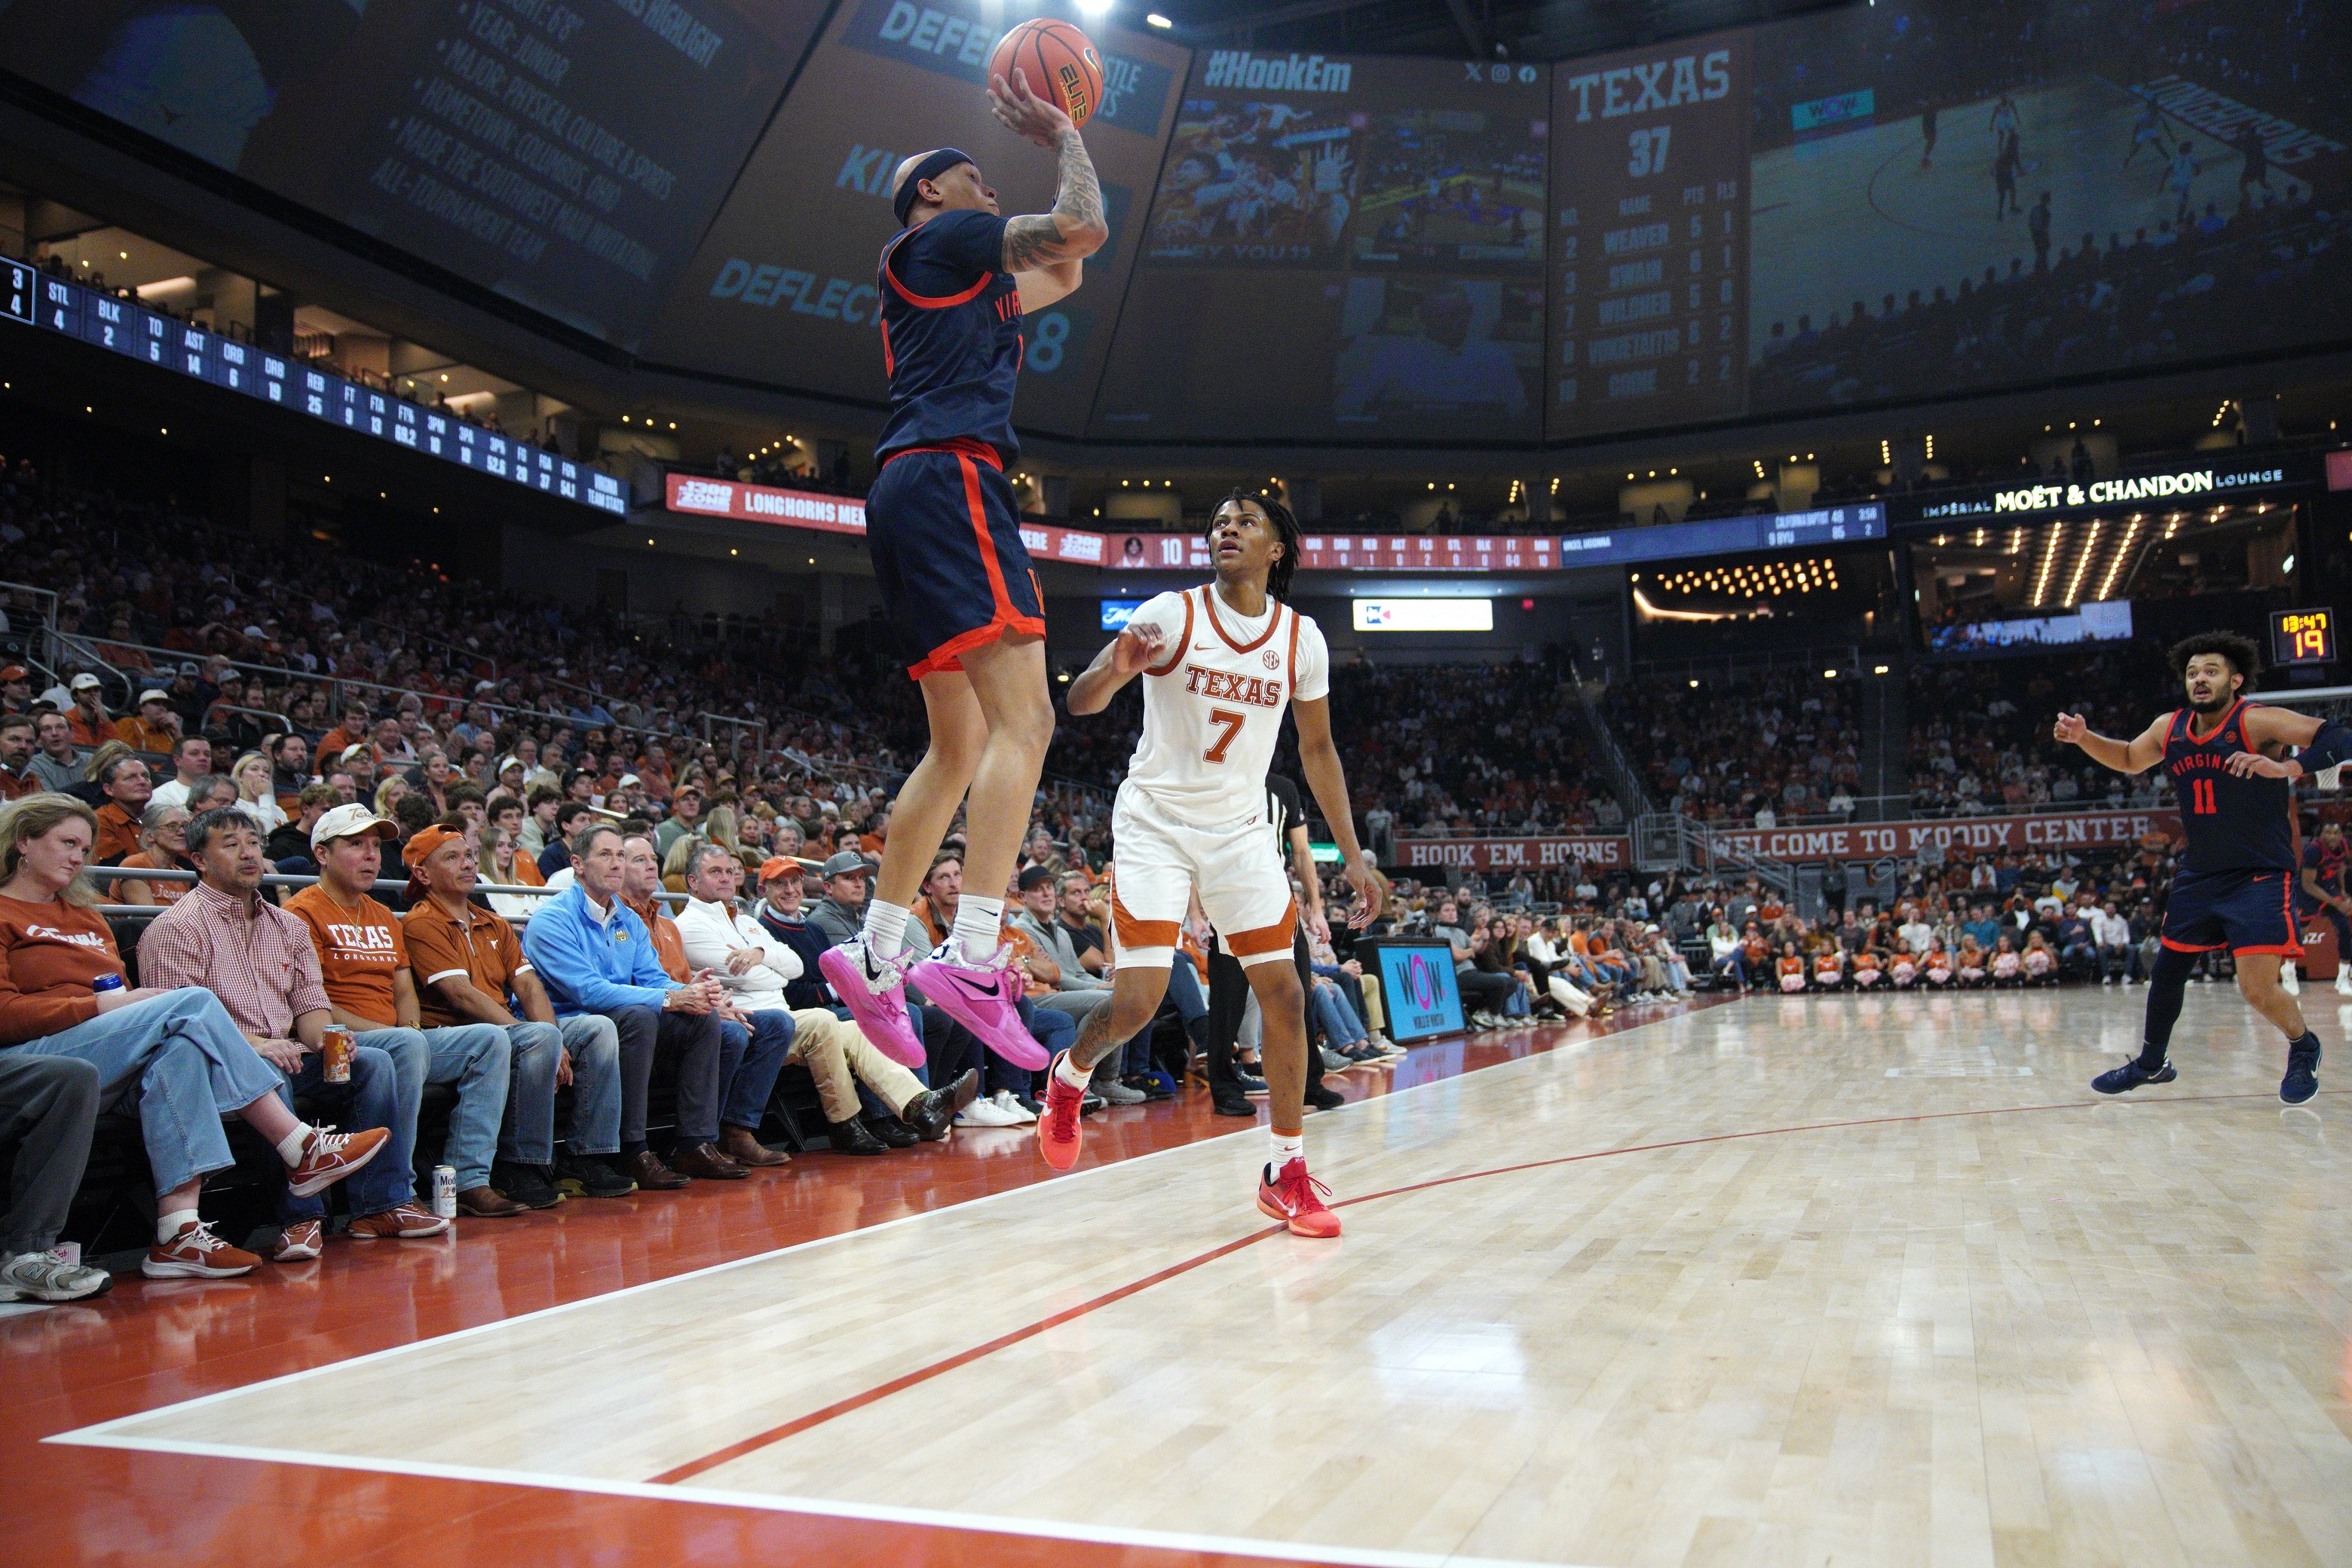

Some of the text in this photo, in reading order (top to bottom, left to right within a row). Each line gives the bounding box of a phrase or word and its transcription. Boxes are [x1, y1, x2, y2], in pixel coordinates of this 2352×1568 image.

[512, 32, 571, 87] JUNIOR
[1204, 50, 1352, 93] #HookEm
[1569, 49, 1729, 123] TEXAS
[1628, 125, 1671, 178] 37
[1566, 235, 1577, 259] 2
[1603, 222, 1669, 255] WEAVER
[1724, 210, 1732, 234] 1
[1723, 245, 1731, 268] 1
[13, 268, 23, 289] 3
[11, 295, 21, 314] 4
[49, 282, 69, 305] STL
[54, 309, 63, 330] 4
[99, 299, 120, 323] BLK
[1565, 304, 1576, 329] 7
[104, 326, 114, 345] 2
[149, 317, 163, 338] TO
[151, 342, 159, 361] 5
[185, 329, 204, 351] AST
[1026, 312, 1070, 372] 8
[188, 355, 201, 375] 14
[224, 343, 244, 365] ORB
[230, 368, 237, 387] 6
[265, 357, 285, 378] DRB
[269, 381, 281, 401] 19
[307, 372, 324, 393] REB
[308, 394, 322, 415] 25
[1995, 485, 2063, 513] MOËT
[2067, 484, 2085, 506] &
[2089, 470, 2213, 503] CHANDON
[2216, 469, 2283, 488] LOUNGE
[745, 492, 835, 522] LONGHORNS
[1865, 523, 1872, 536] 2
[1162, 537, 1182, 565] 10
[1425, 553, 1431, 566] 2
[2283, 613, 2326, 632] 13:47
[2295, 629, 2324, 658] 19
[1263, 652, 1279, 669] SEC
[1185, 663, 1282, 709] TEXAS
[1203, 707, 1245, 764] 7
[2193, 779, 2217, 814] 11
[1711, 831, 1849, 859] WELCOME
[1860, 829, 1897, 853] TO
[2024, 816, 2149, 844] CENTER
[1410, 844, 1475, 866] HOOK
[1539, 842, 1619, 865] HORNS
[326, 923, 394, 949] TEXAS
[334, 953, 398, 962] LONGHORNS
